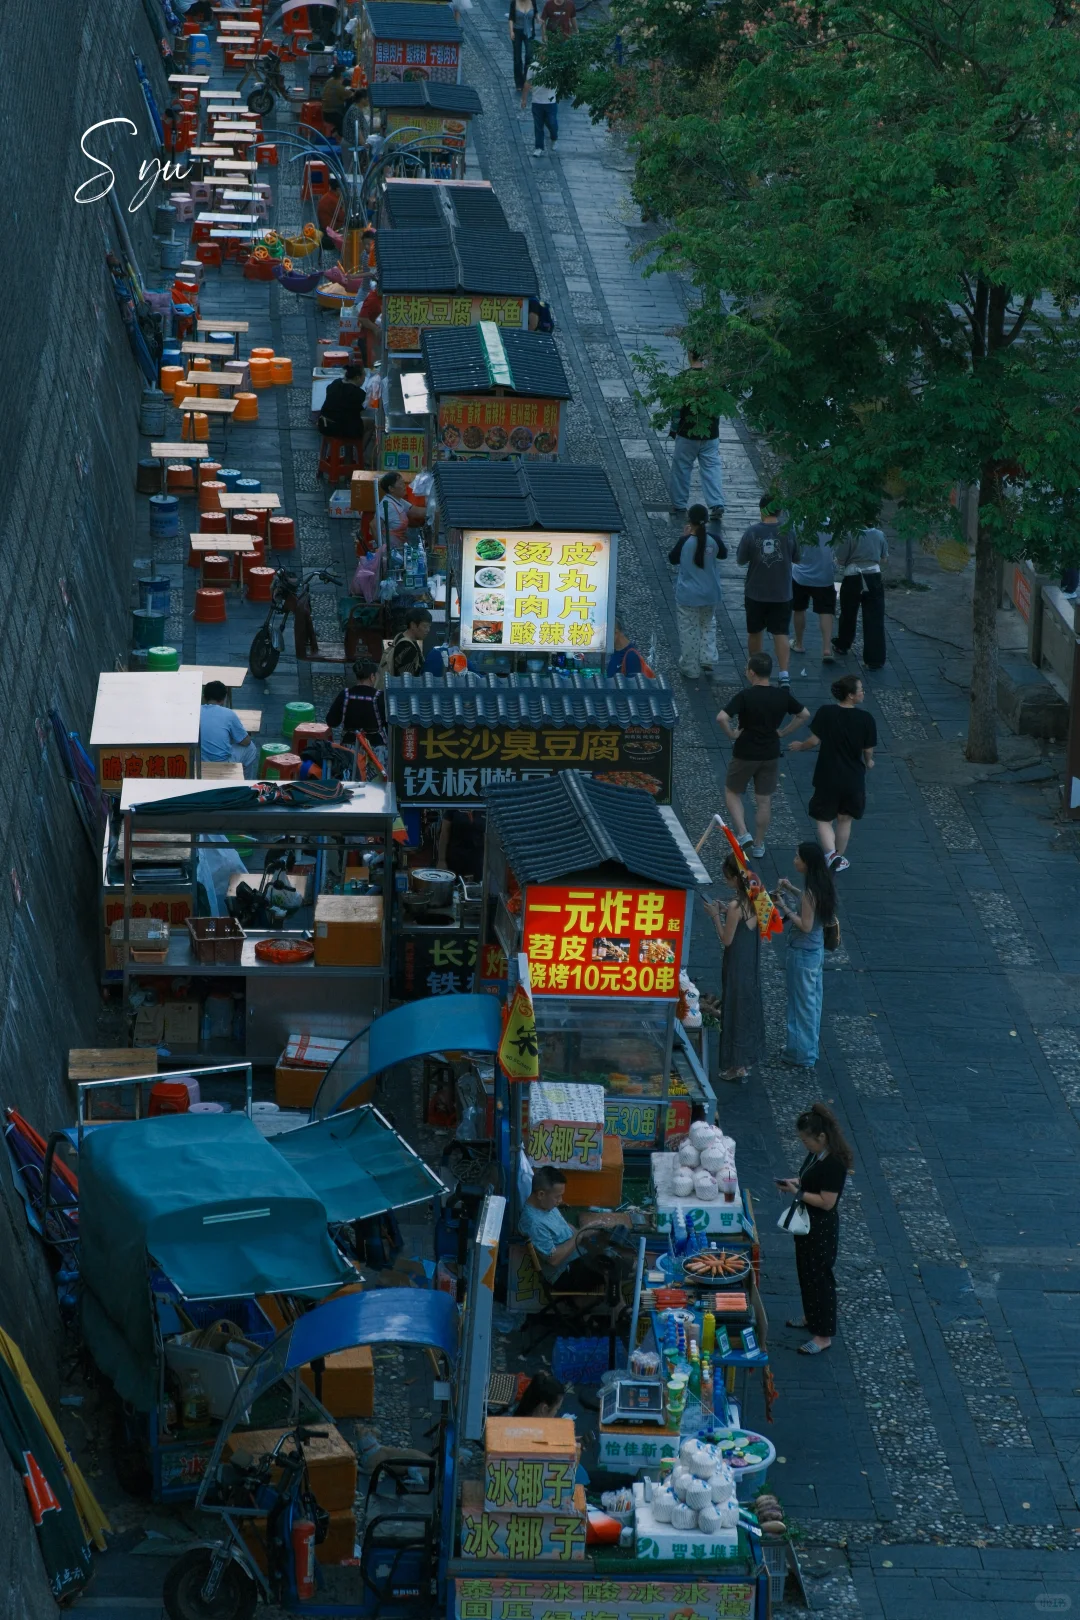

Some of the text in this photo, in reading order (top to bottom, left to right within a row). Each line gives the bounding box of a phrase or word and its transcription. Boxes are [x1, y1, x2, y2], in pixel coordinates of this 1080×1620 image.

[387, 296, 523, 327] 铁板豆腐 鱿鱼
[512, 540, 598, 567] 烫皮
[515, 567, 597, 593] 肉丸
[514, 594, 597, 620] 肉片
[509, 620, 596, 646] 酸辣粉
[419, 727, 622, 761] 长沙臭豆腐
[529, 889, 681, 936] 一元炸串 起
[528, 933, 587, 962] 苕皮
[528, 962, 675, 993] 烧烤10元30串
[528, 1123, 599, 1165] 冰椰子
[486, 1457, 574, 1508] 冰椰子
[463, 1513, 585, 1560] 冰椰子
